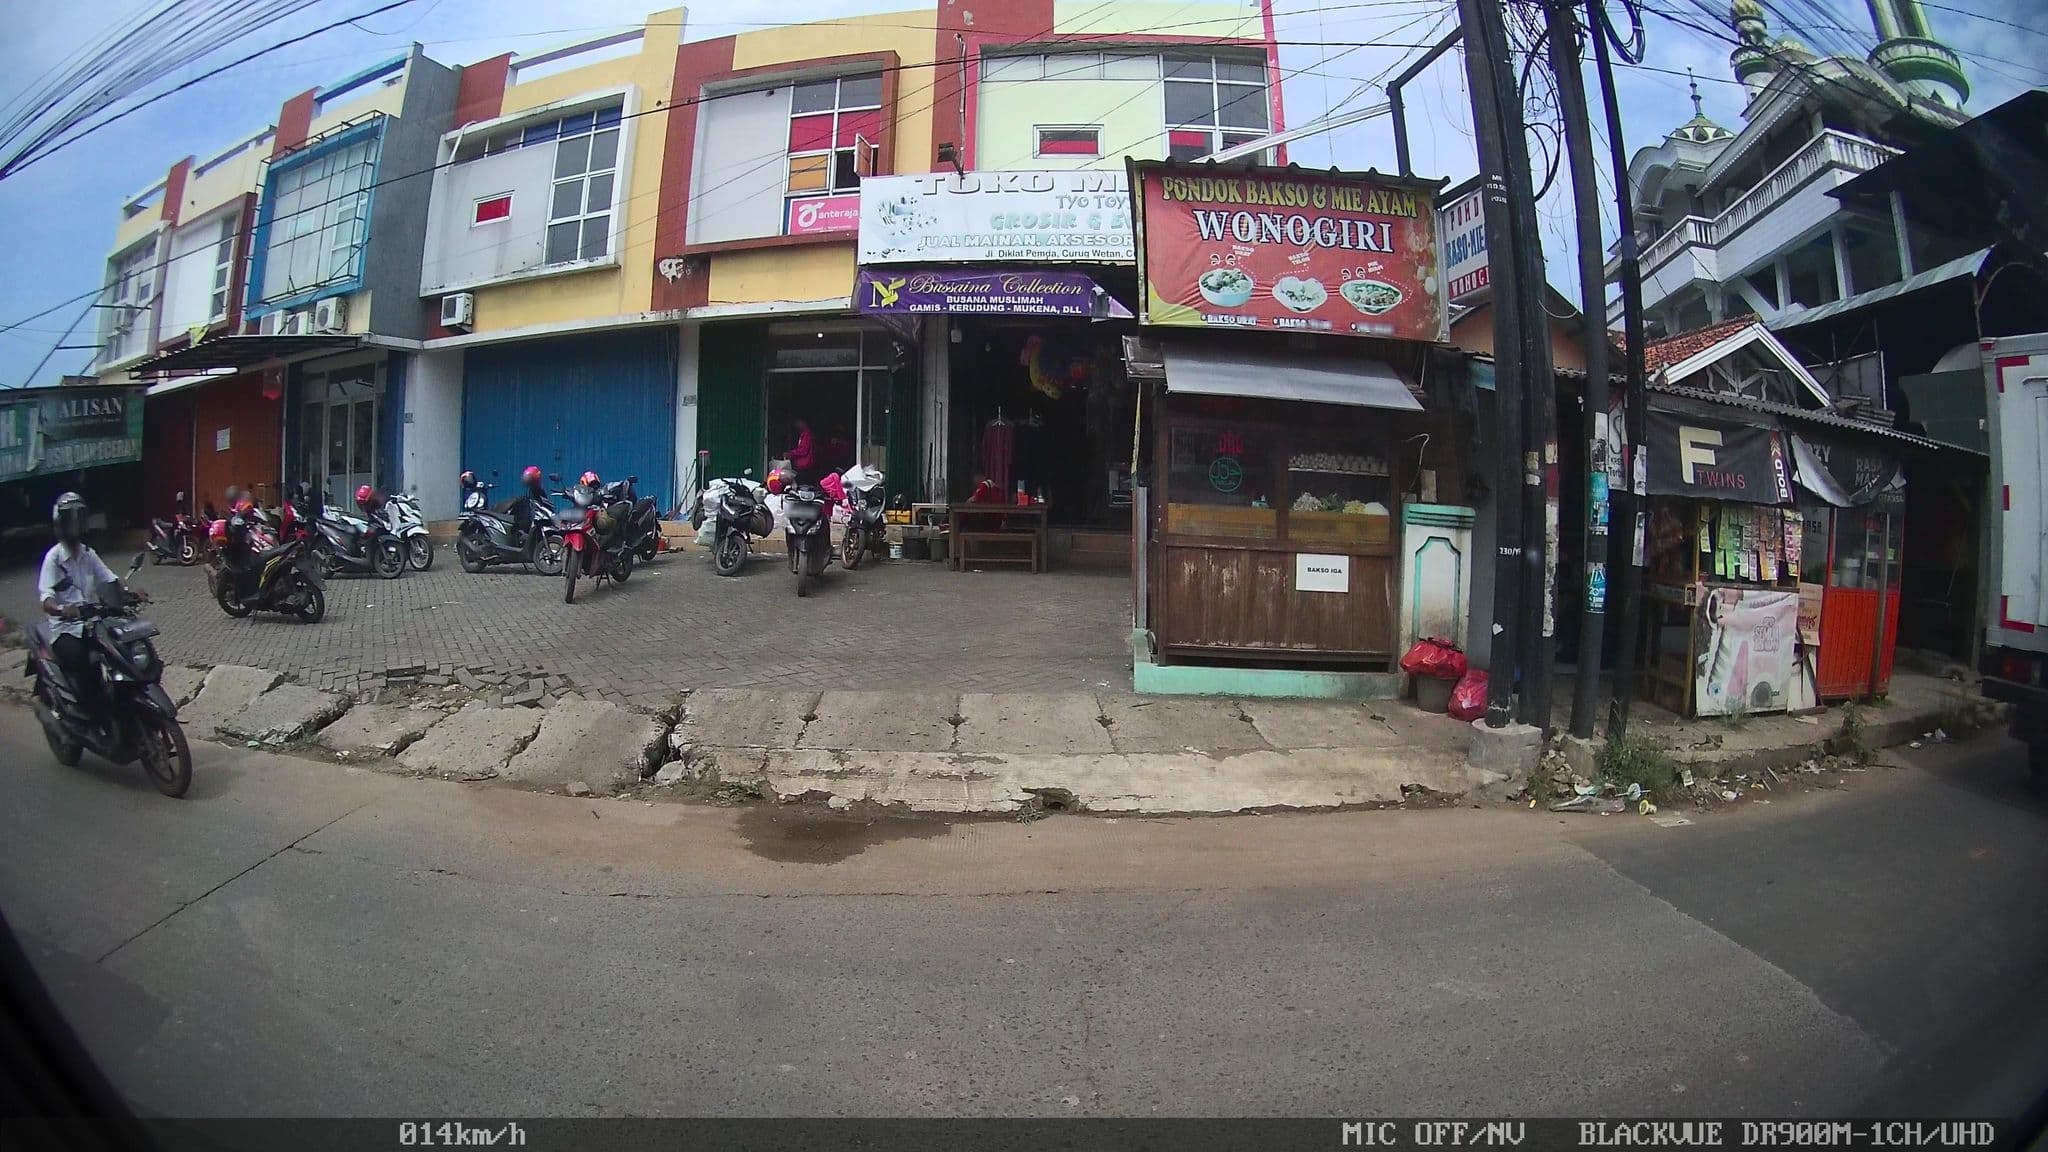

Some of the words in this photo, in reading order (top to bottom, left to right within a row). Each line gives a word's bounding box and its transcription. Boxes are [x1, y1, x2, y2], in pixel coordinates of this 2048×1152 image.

[915, 174, 1055, 196] TOKO
[1161, 176, 1243, 204] PONDOK
[1242, 180, 1310, 208] BAKSO
[1312, 185, 1327, 209] &
[1330, 186, 1364, 213] MIE
[1367, 189, 1418, 218] AYAM
[818, 208, 859, 218] anteraja
[990, 212, 1077, 231] GROSIR
[1193, 209, 1395, 254] WONOGIRI
[918, 235, 960, 249] JUAL
[998, 249, 1024, 258] Diklat
[1062, 249, 1090, 259] Curug
[1092, 250, 1124, 259] Wetan,
[909, 275, 992, 294] Bussaina
[998, 273, 1084, 295] Collection
[910, 304, 941, 312] GAMIS
[949, 304, 1005, 312] KERUDUNG
[1013, 305, 1060, 314] MUKENA,
[1063, 306, 1082, 314] DLL
[946, 296, 987, 304] BUSANA
[989, 296, 1044, 304] MUSLIMAH
[1679, 425, 1723, 485] F
[1697, 470, 1746, 490] TWINS
[1774, 459, 1789, 498] BOLD
